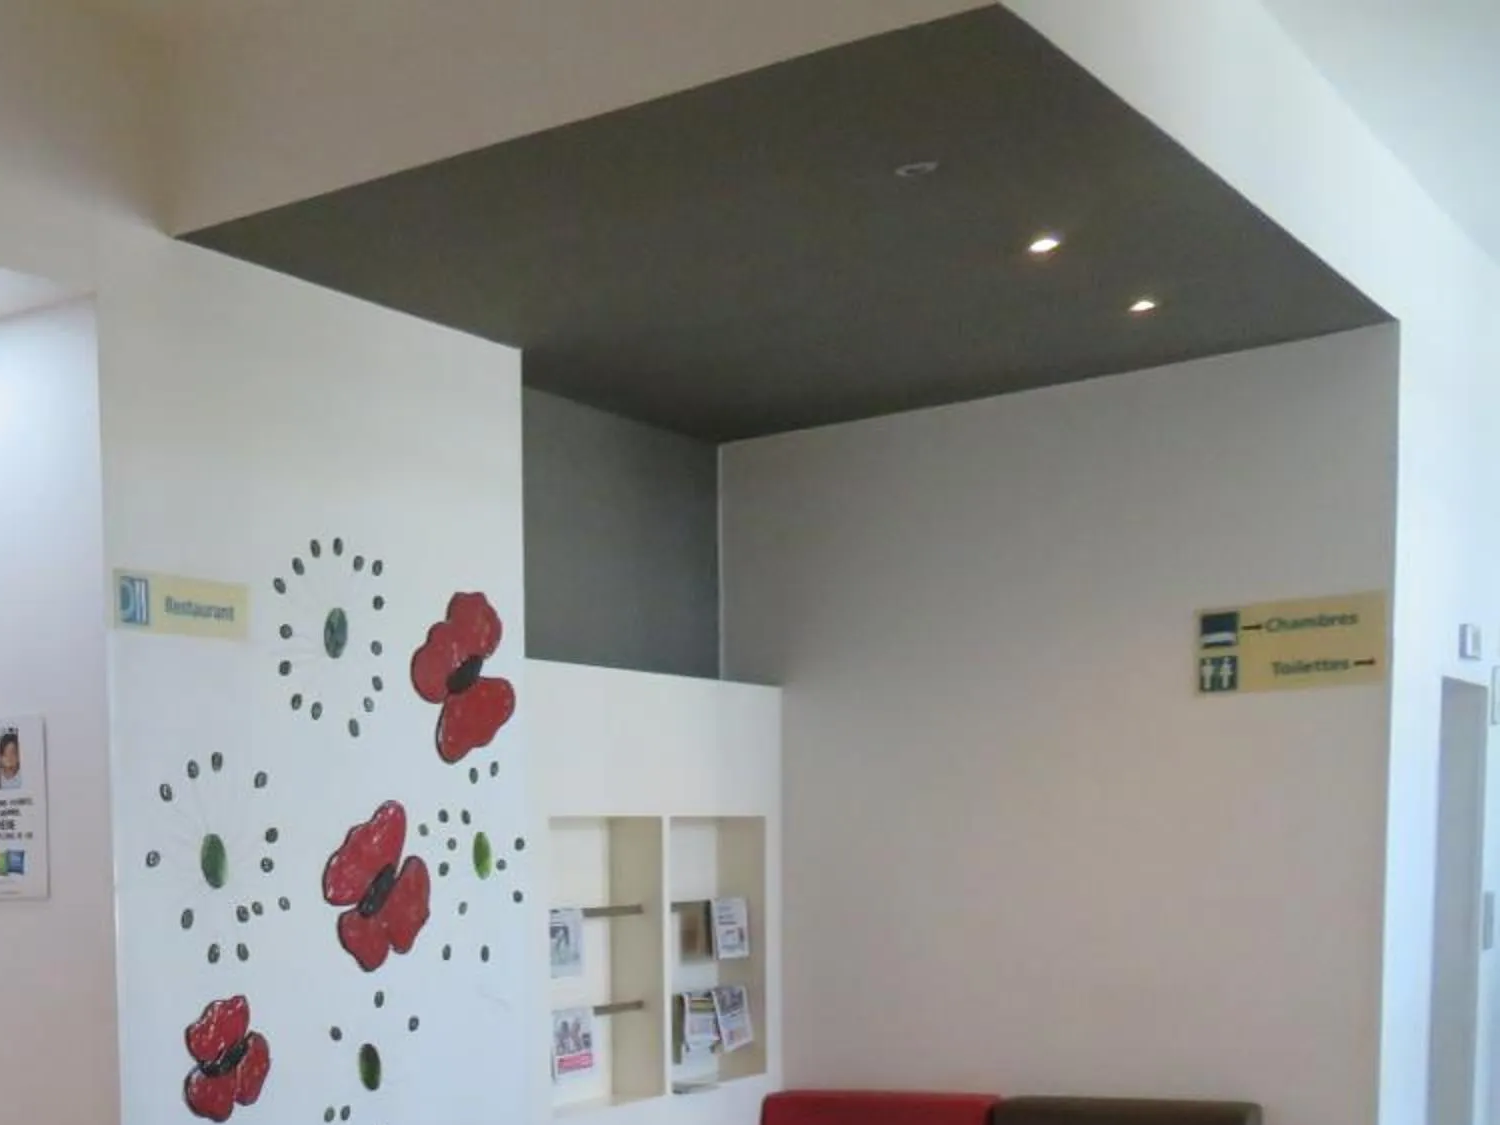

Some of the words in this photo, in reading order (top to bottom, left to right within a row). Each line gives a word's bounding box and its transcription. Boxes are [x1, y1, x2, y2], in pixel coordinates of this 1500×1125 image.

[164, 595, 234, 621] Restaurant
[1266, 613, 1358, 632] Chambres
[1272, 659, 1350, 677] Toilettes
